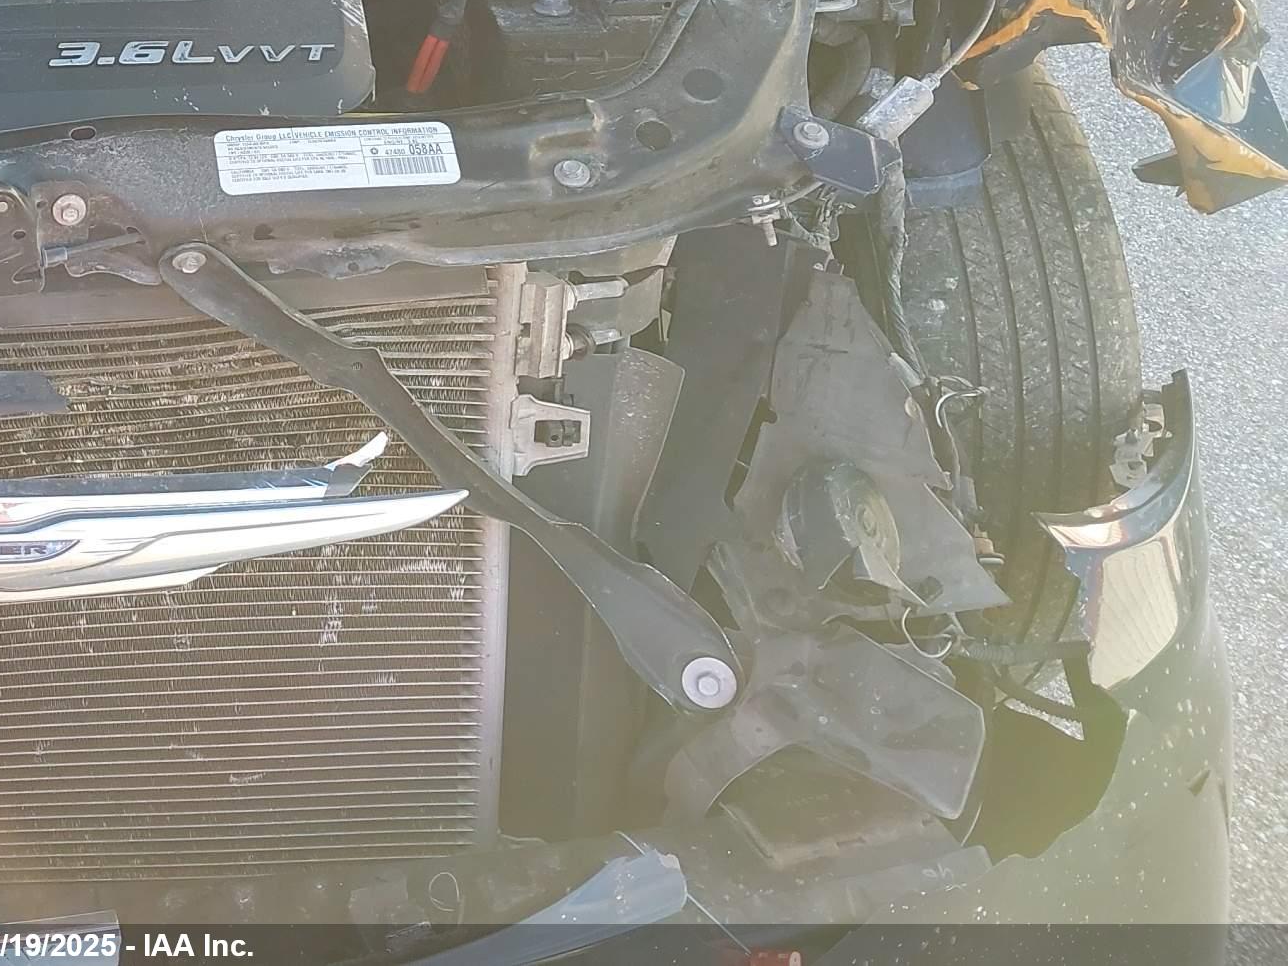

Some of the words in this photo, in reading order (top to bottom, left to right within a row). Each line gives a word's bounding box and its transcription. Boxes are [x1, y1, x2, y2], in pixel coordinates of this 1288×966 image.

[48, 40, 215, 67] 3.6L
[217, 44, 336, 63] VVT
[225, 133, 255, 142] Chrysler
[256, 133, 277, 141] Group
[294, 131, 322, 139] VEHICLE
[324, 130, 357, 138] EMISSION
[358, 128, 390, 136] CONTROL
[391, 126, 438, 135] INFORMATION
[409, 143, 443, 155] 058AA
